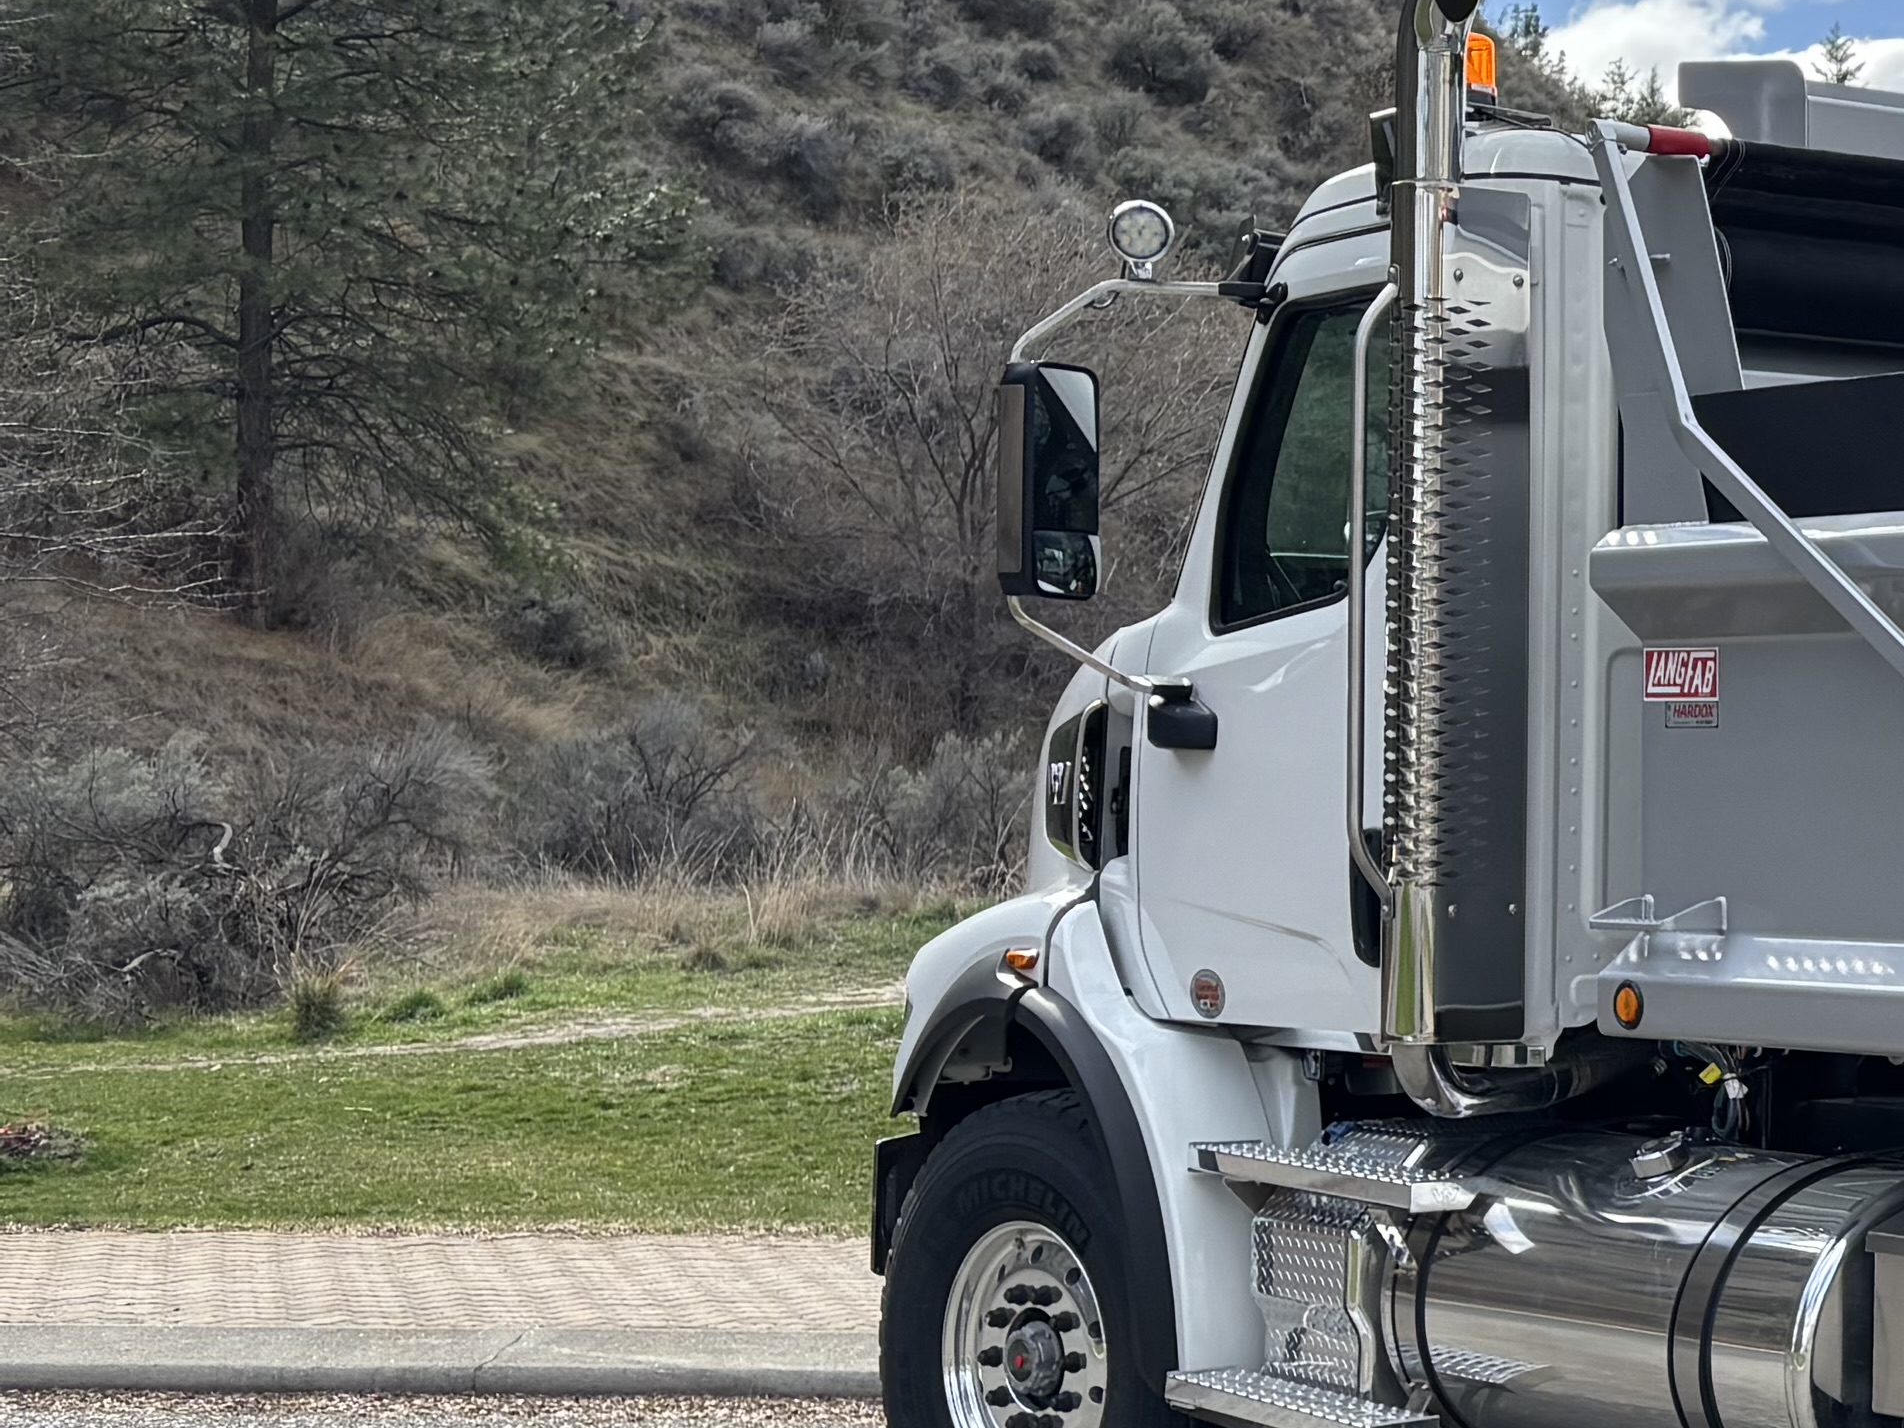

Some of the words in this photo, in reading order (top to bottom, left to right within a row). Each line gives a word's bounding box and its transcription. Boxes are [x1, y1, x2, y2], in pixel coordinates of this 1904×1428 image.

[1646, 651, 1716, 693] LANGFAB
[1672, 703, 1715, 719] HARDOX
[956, 1172, 1090, 1244] MICHELIN
